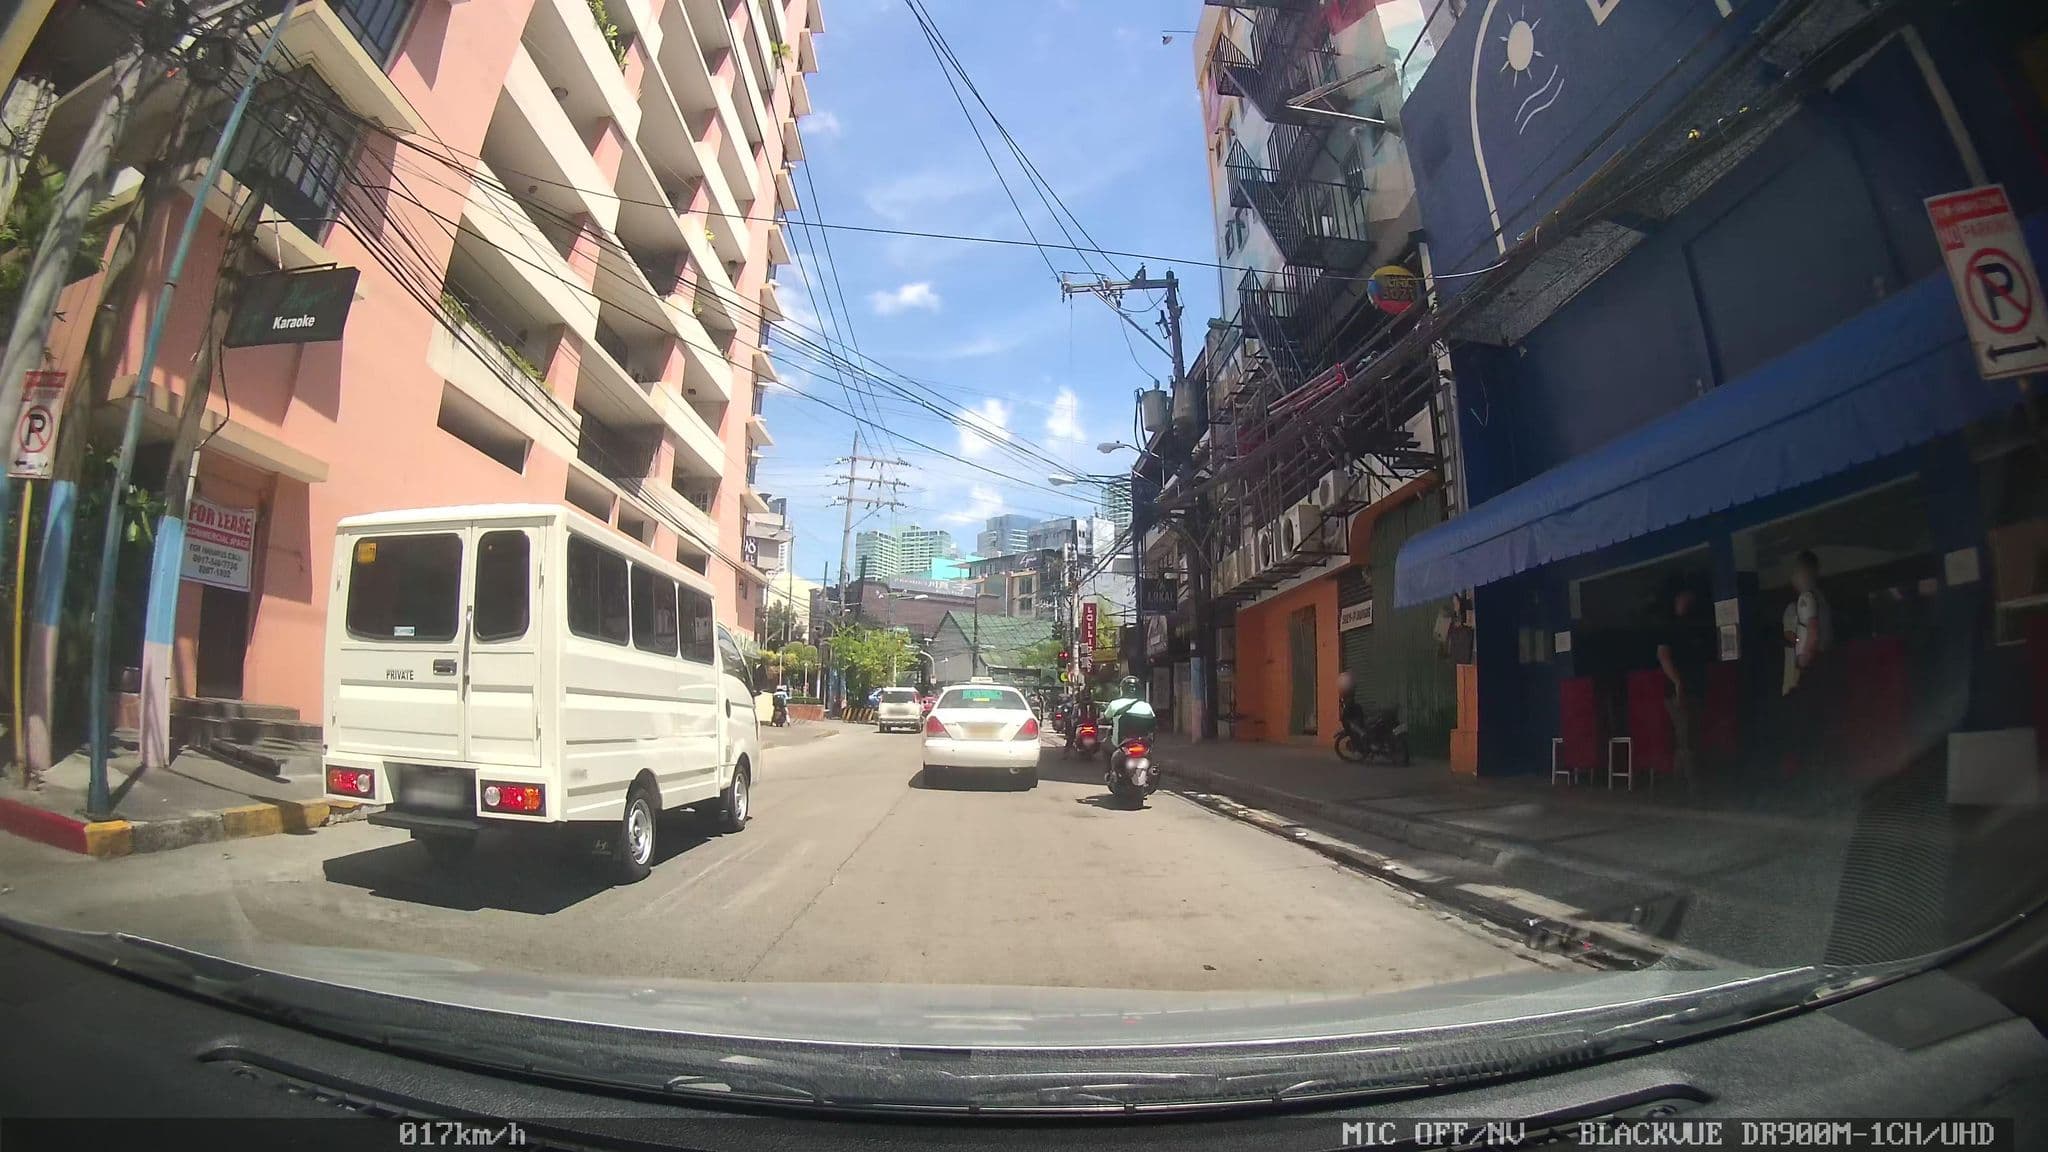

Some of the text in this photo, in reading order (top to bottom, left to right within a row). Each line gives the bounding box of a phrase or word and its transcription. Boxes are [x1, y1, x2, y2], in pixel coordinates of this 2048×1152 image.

[272, 314, 315, 330] Karaoke
[188, 502, 252, 535] FOR LEASE
[386, 669, 415, 681] PRIVATE
